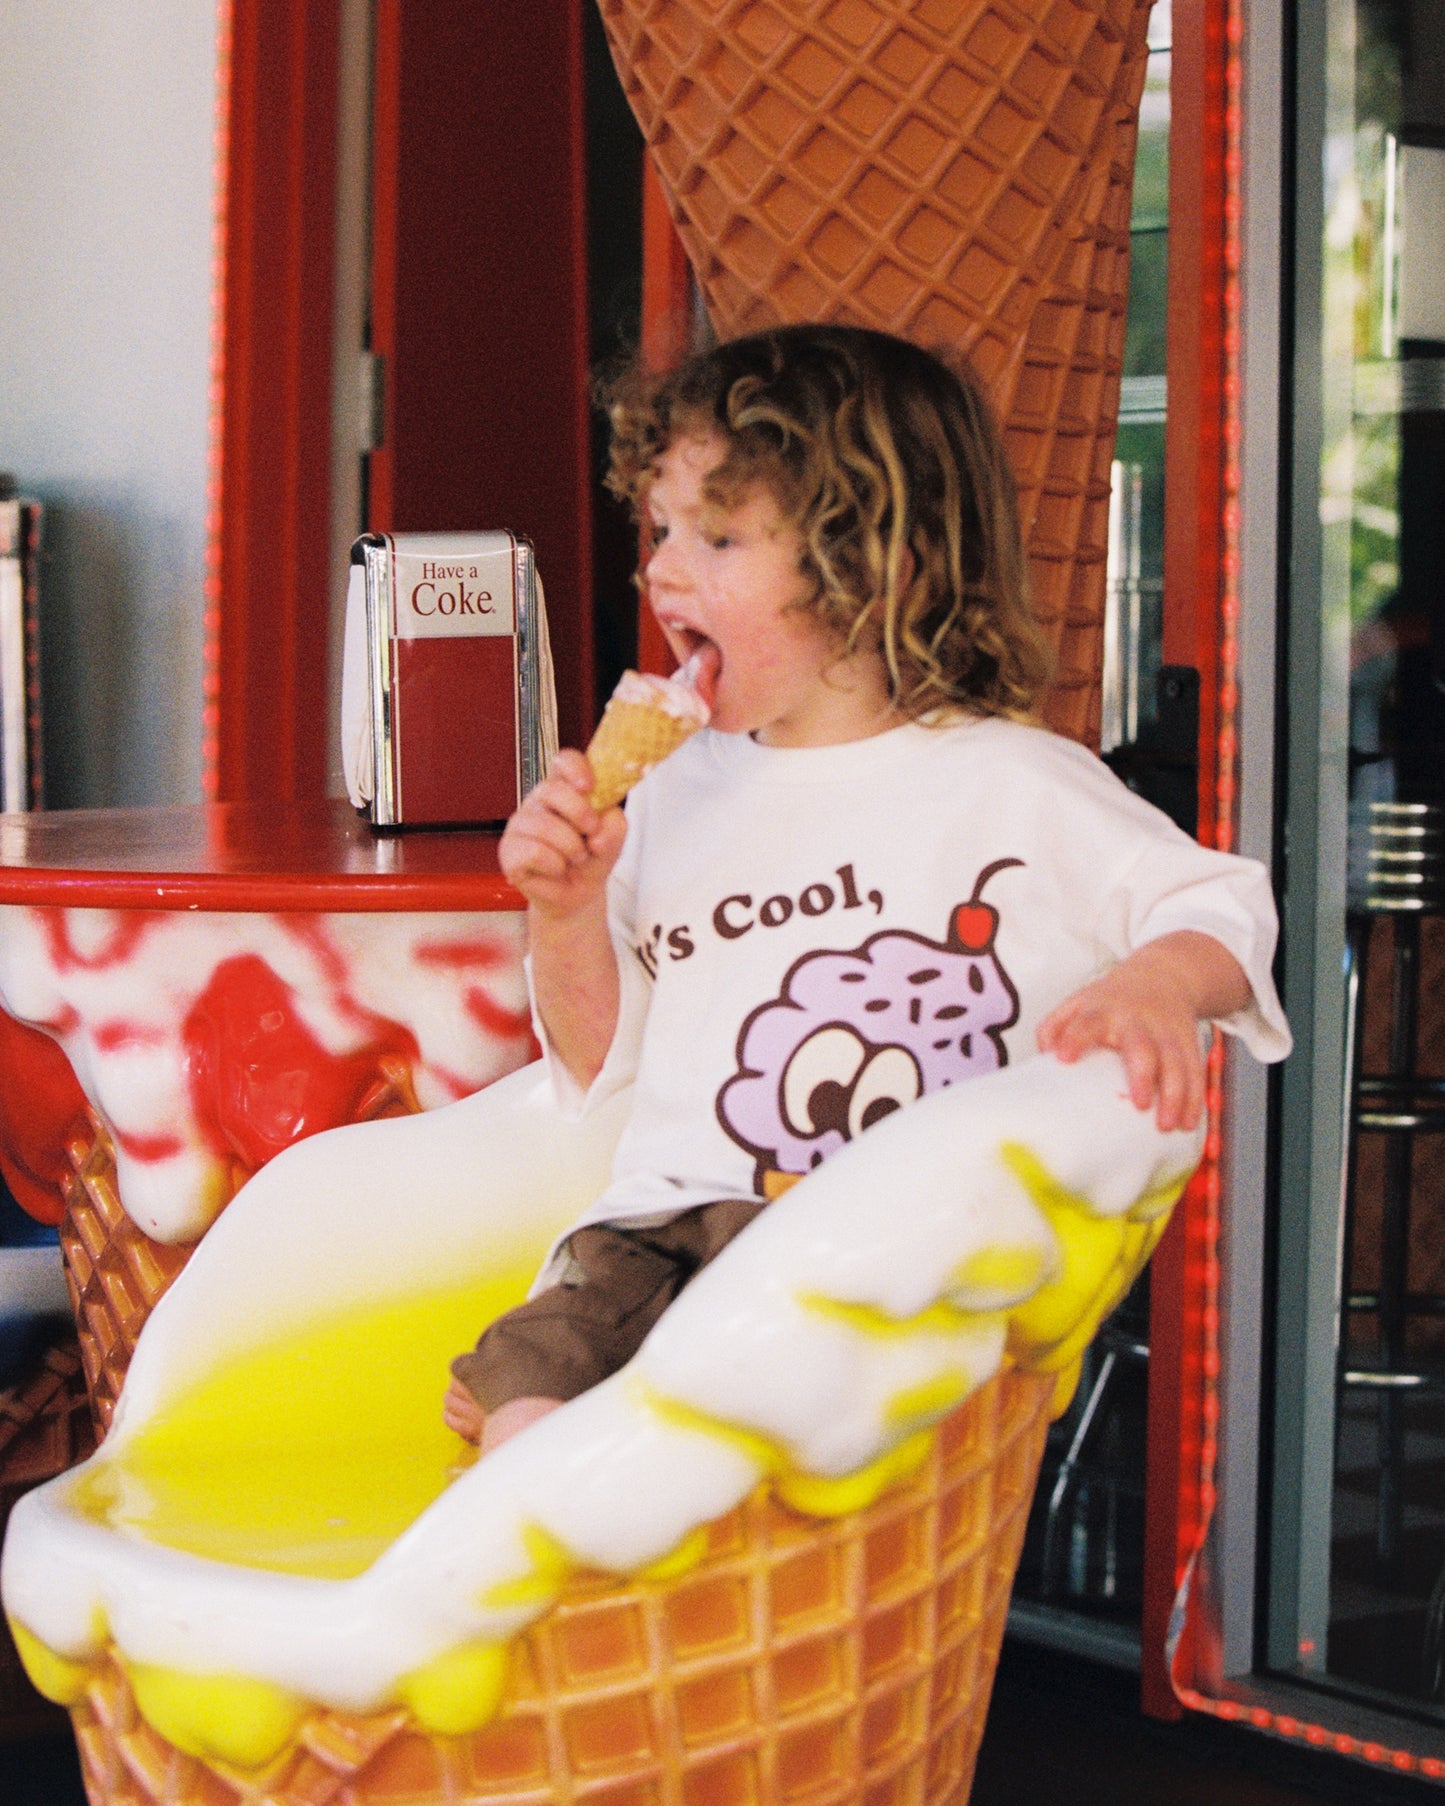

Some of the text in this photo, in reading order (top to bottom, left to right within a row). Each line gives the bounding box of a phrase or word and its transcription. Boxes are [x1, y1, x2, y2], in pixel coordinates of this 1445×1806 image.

[423, 562, 478, 579] Have a
[411, 582, 494, 616] Coke
[712, 863, 883, 939] Cool,
